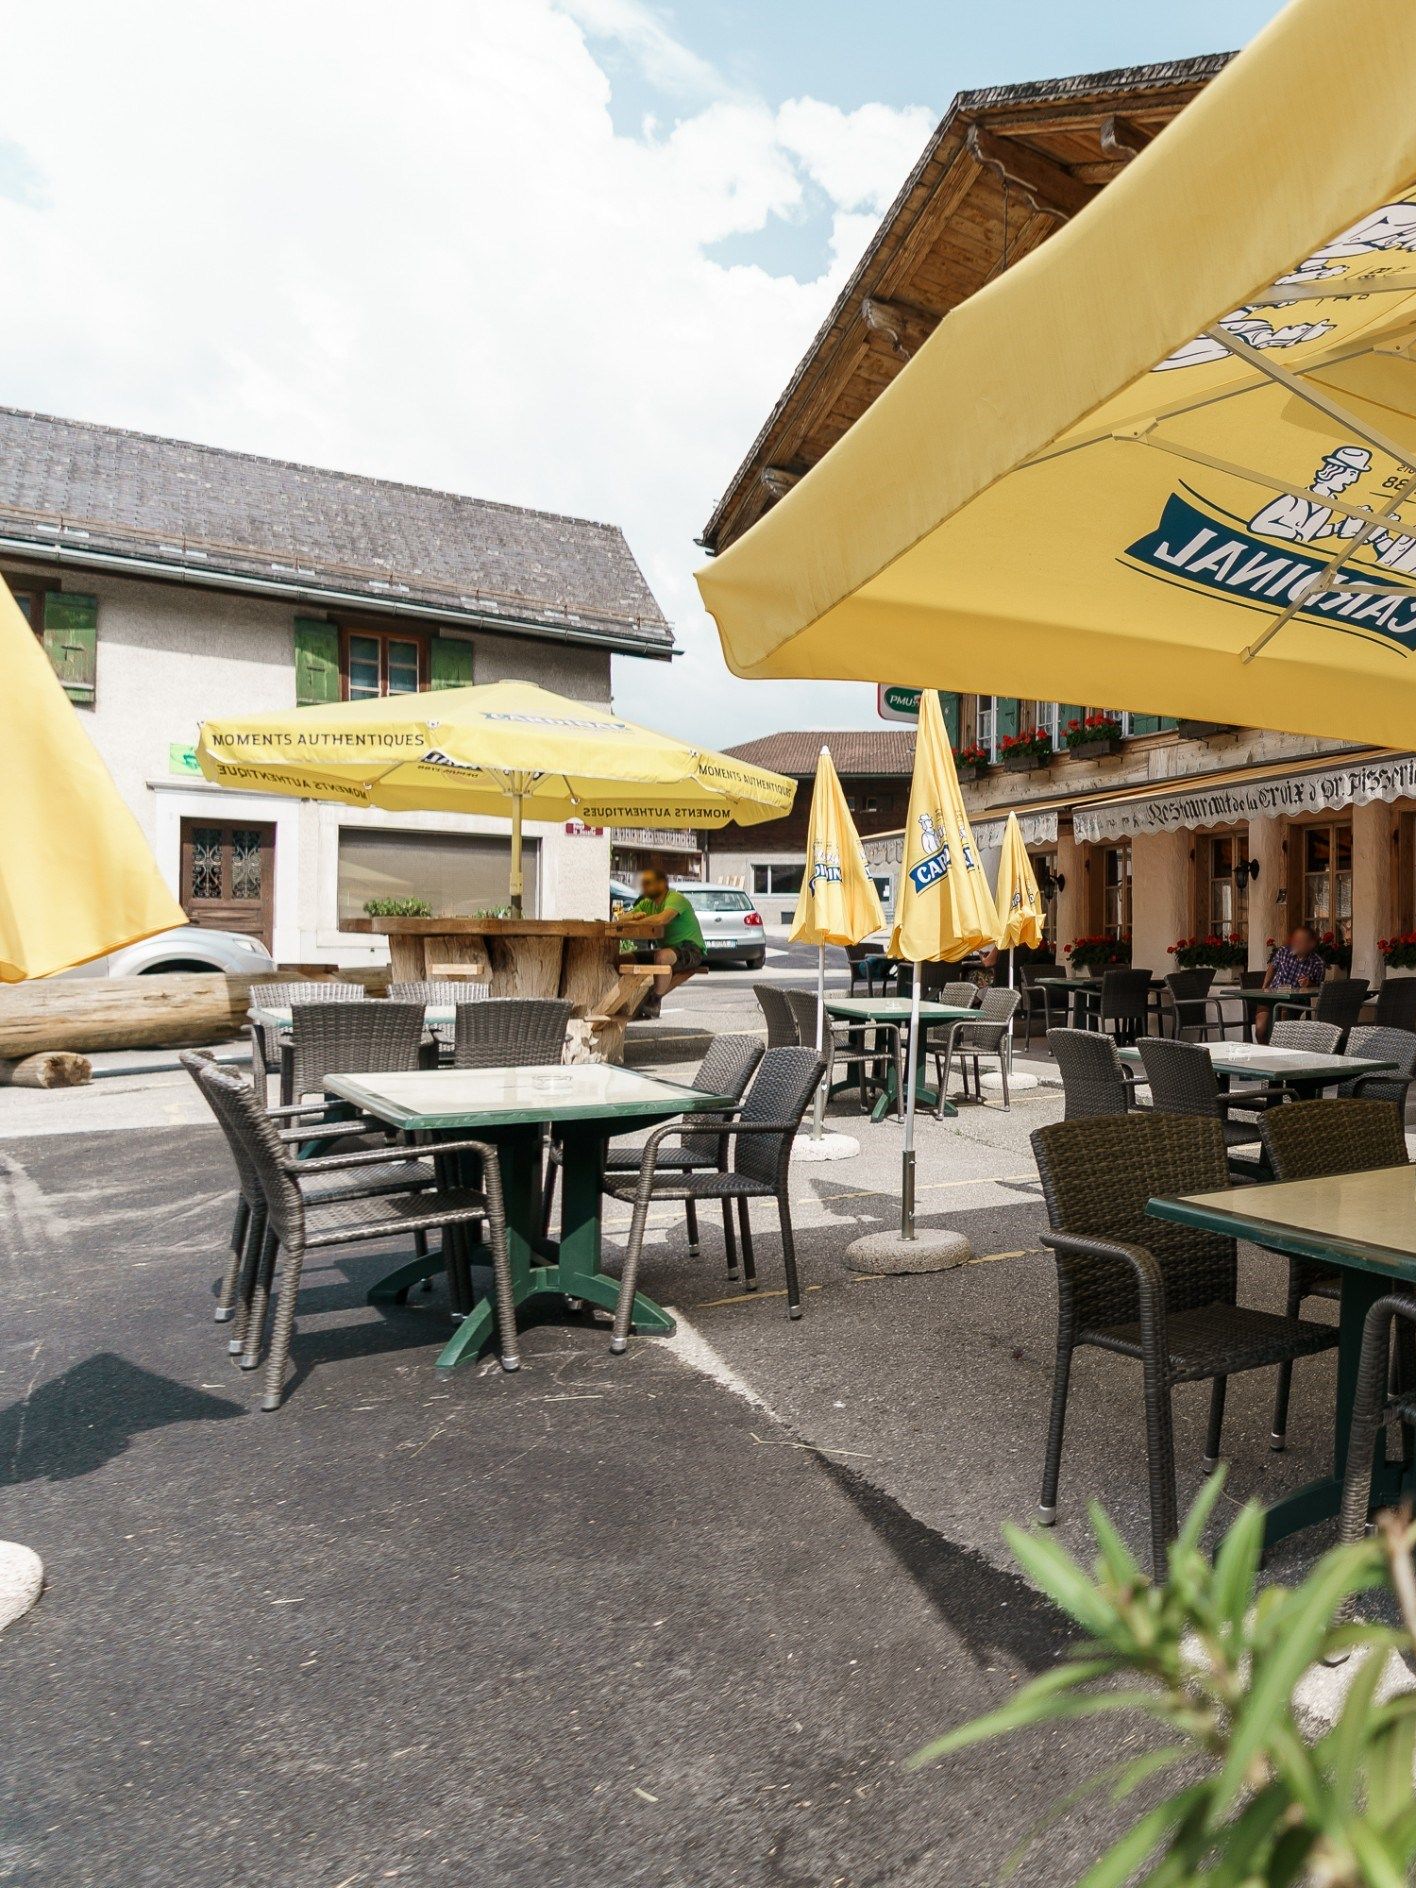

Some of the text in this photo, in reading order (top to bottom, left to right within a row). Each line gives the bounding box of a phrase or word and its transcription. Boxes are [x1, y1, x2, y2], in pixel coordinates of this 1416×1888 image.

[212, 733, 425, 746] MOMENTS AUTHENTIQUES
[698, 764, 741, 782] MOMENTS
[1147, 791, 1233, 826] Restaurant
[1233, 797, 1245, 812] de
[1258, 780, 1304, 808] Croix
